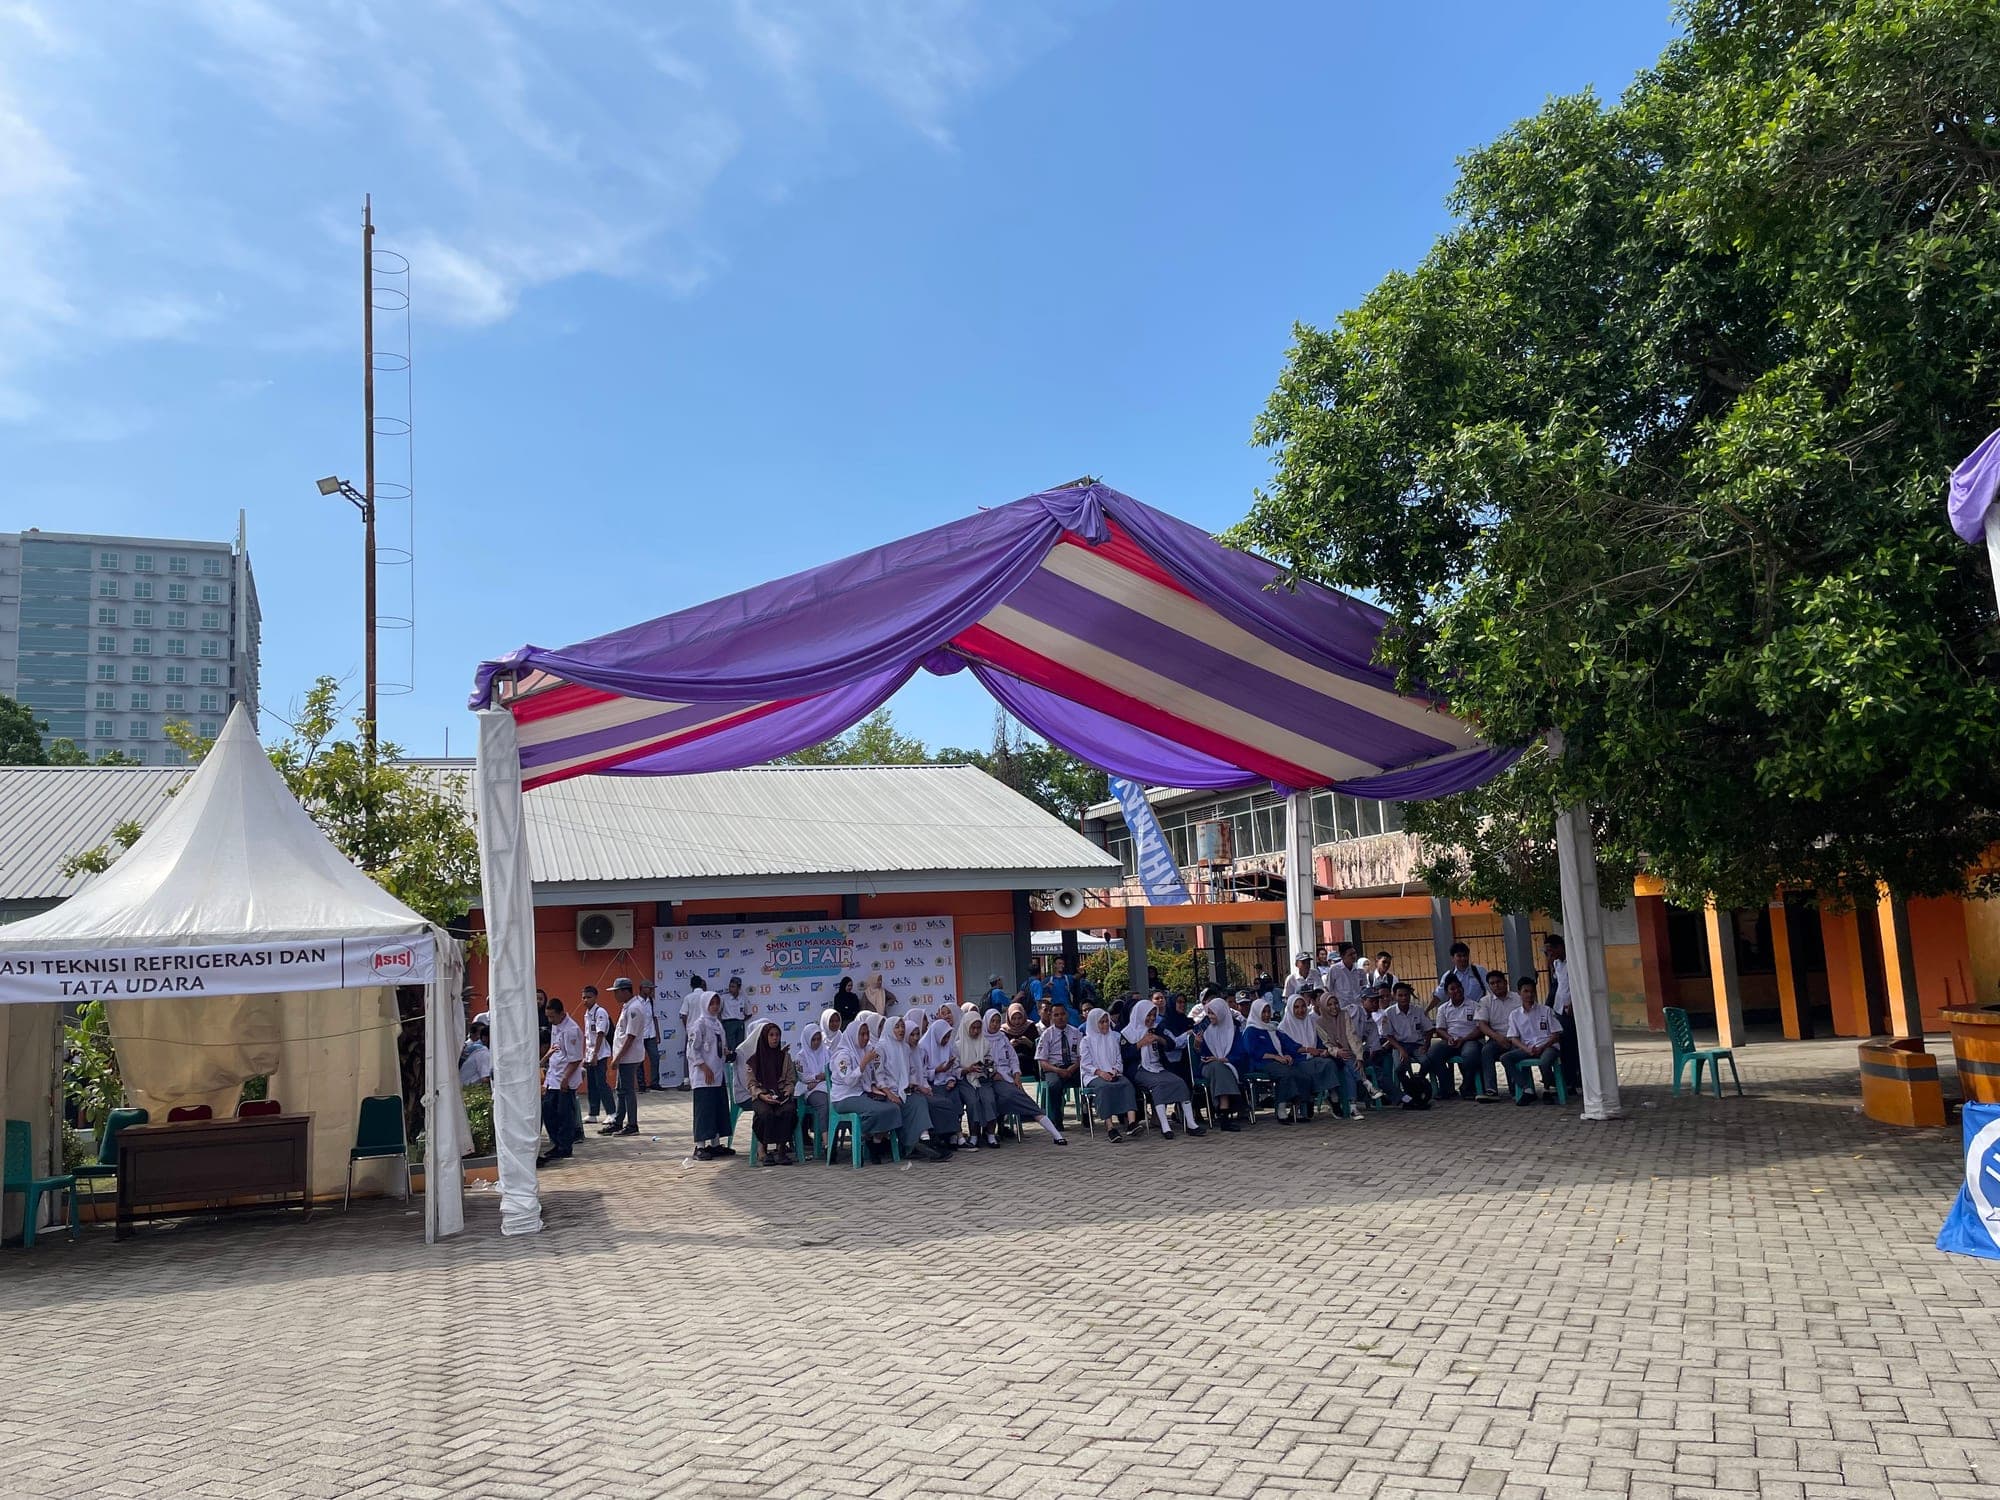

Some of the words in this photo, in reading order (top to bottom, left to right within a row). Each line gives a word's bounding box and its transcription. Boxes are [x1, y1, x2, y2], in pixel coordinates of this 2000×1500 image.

[906, 922, 917, 932] 10
[678, 930, 689, 940] 10
[766, 941, 791, 951] SMKN
[805, 939, 854, 947] MAKASSAR
[892, 941, 904, 951] 10
[374, 950, 411, 969] ASISI
[661, 950, 673, 960] 10
[765, 949, 803, 967] JOB
[808, 946, 854, 964] FAIR
[0, 960, 35, 975] ASI
[41, 958, 126, 974] TEKNISI
[134, 951, 272, 972] REFRIGERASI
[280, 948, 325, 965] DAN
[884, 960, 895, 969] 10
[934, 975, 945, 985] 10
[60, 980, 118, 996] TATA
[126, 975, 205, 993] UDARA
[760, 984, 771, 994] 10
[923, 994, 933, 1004] 10
